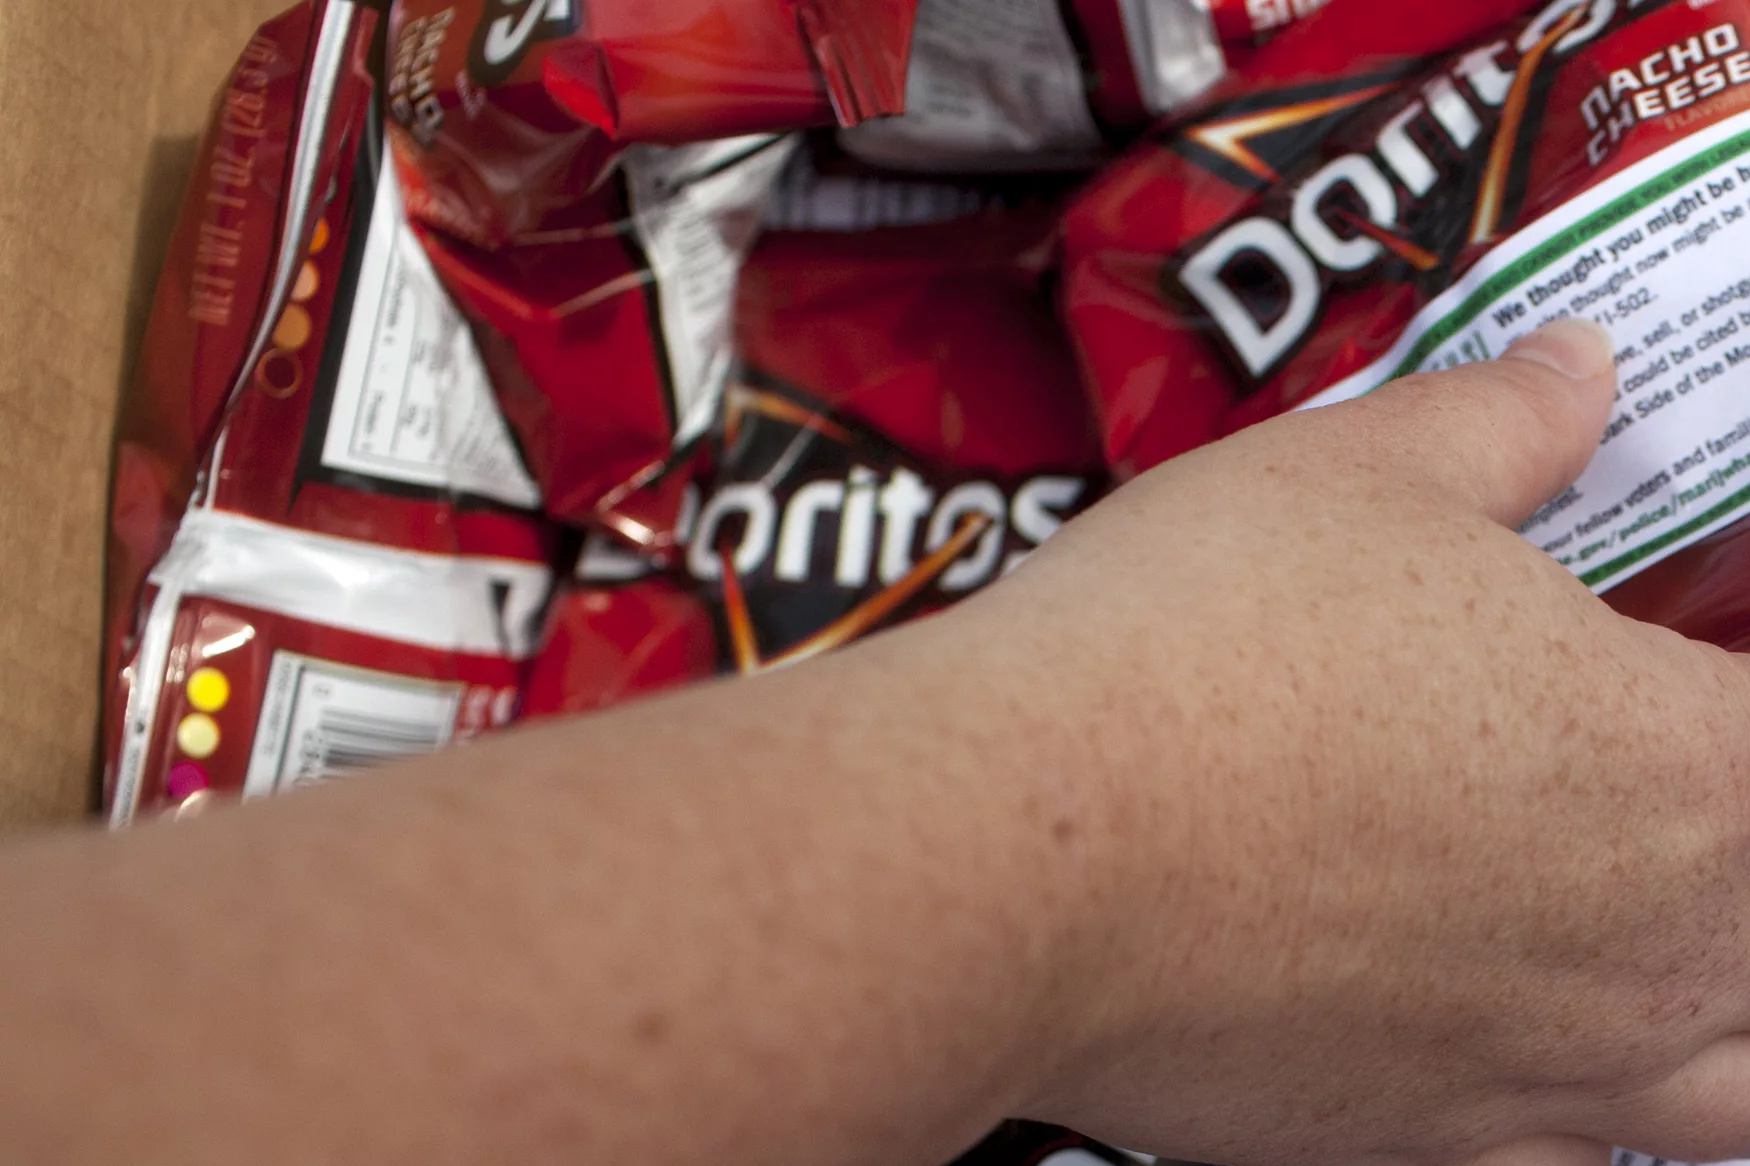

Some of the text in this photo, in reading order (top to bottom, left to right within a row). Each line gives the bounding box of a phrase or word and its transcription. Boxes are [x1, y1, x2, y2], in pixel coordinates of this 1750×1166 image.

[1581, 21, 1742, 126] NACHO
[1490, 297, 1529, 330] We
[1526, 247, 1607, 308] thought
[1606, 228, 1645, 263] you
[1644, 189, 1708, 236] might
[1706, 176, 1736, 200] be
[575, 464, 1085, 592] oritos
